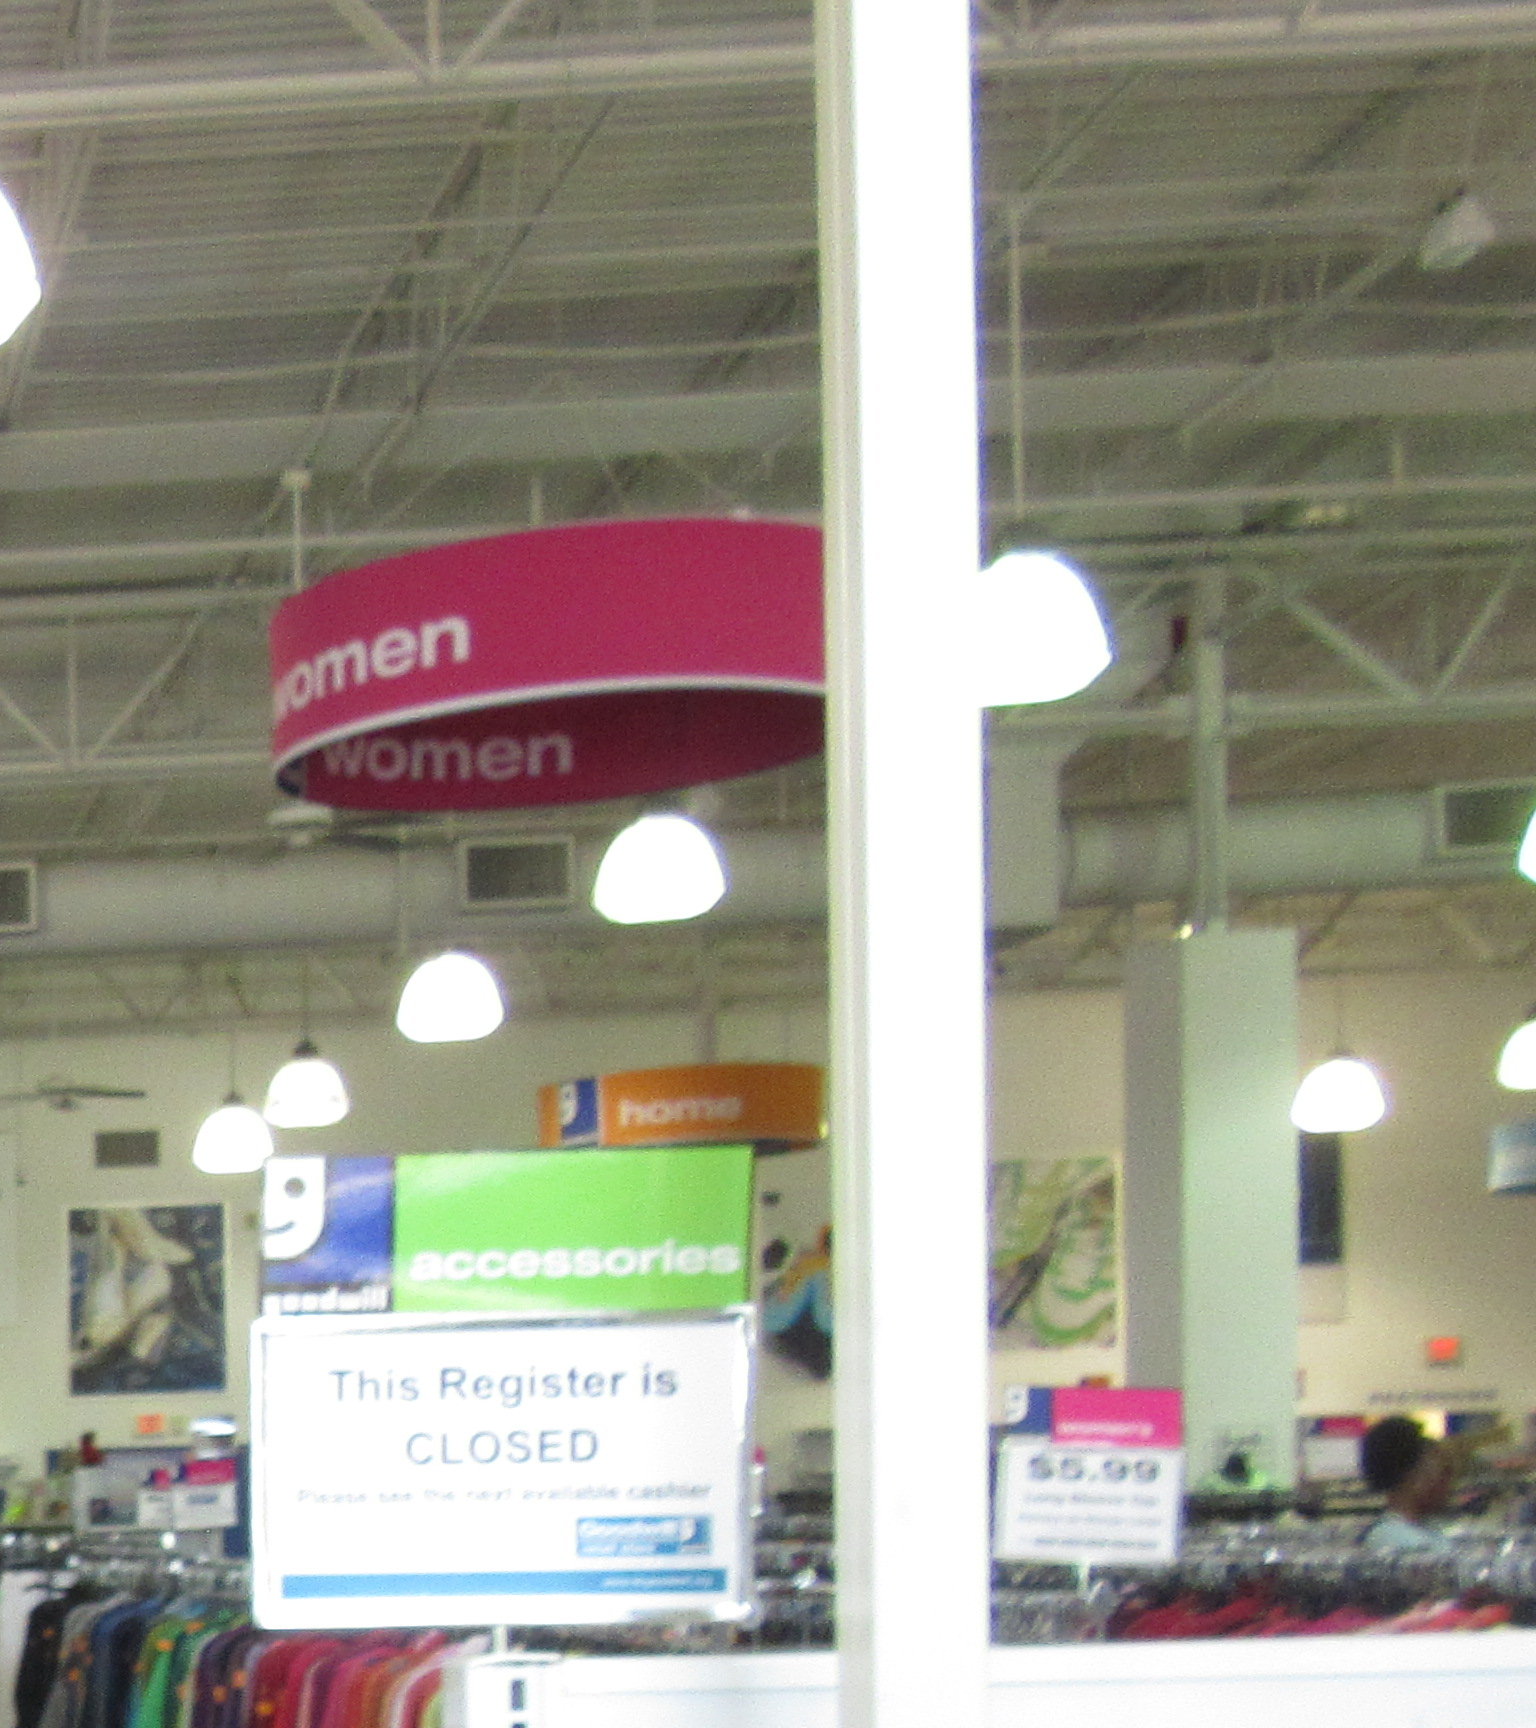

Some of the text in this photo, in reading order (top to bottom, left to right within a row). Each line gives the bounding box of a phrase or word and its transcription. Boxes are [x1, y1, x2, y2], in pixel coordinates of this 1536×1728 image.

[324, 733, 573, 781] women
[618, 1095, 745, 1128] home
[409, 1237, 743, 1283] accessories
[329, 1361, 679, 1408] This Register is
[406, 1428, 600, 1466] CLOSED
